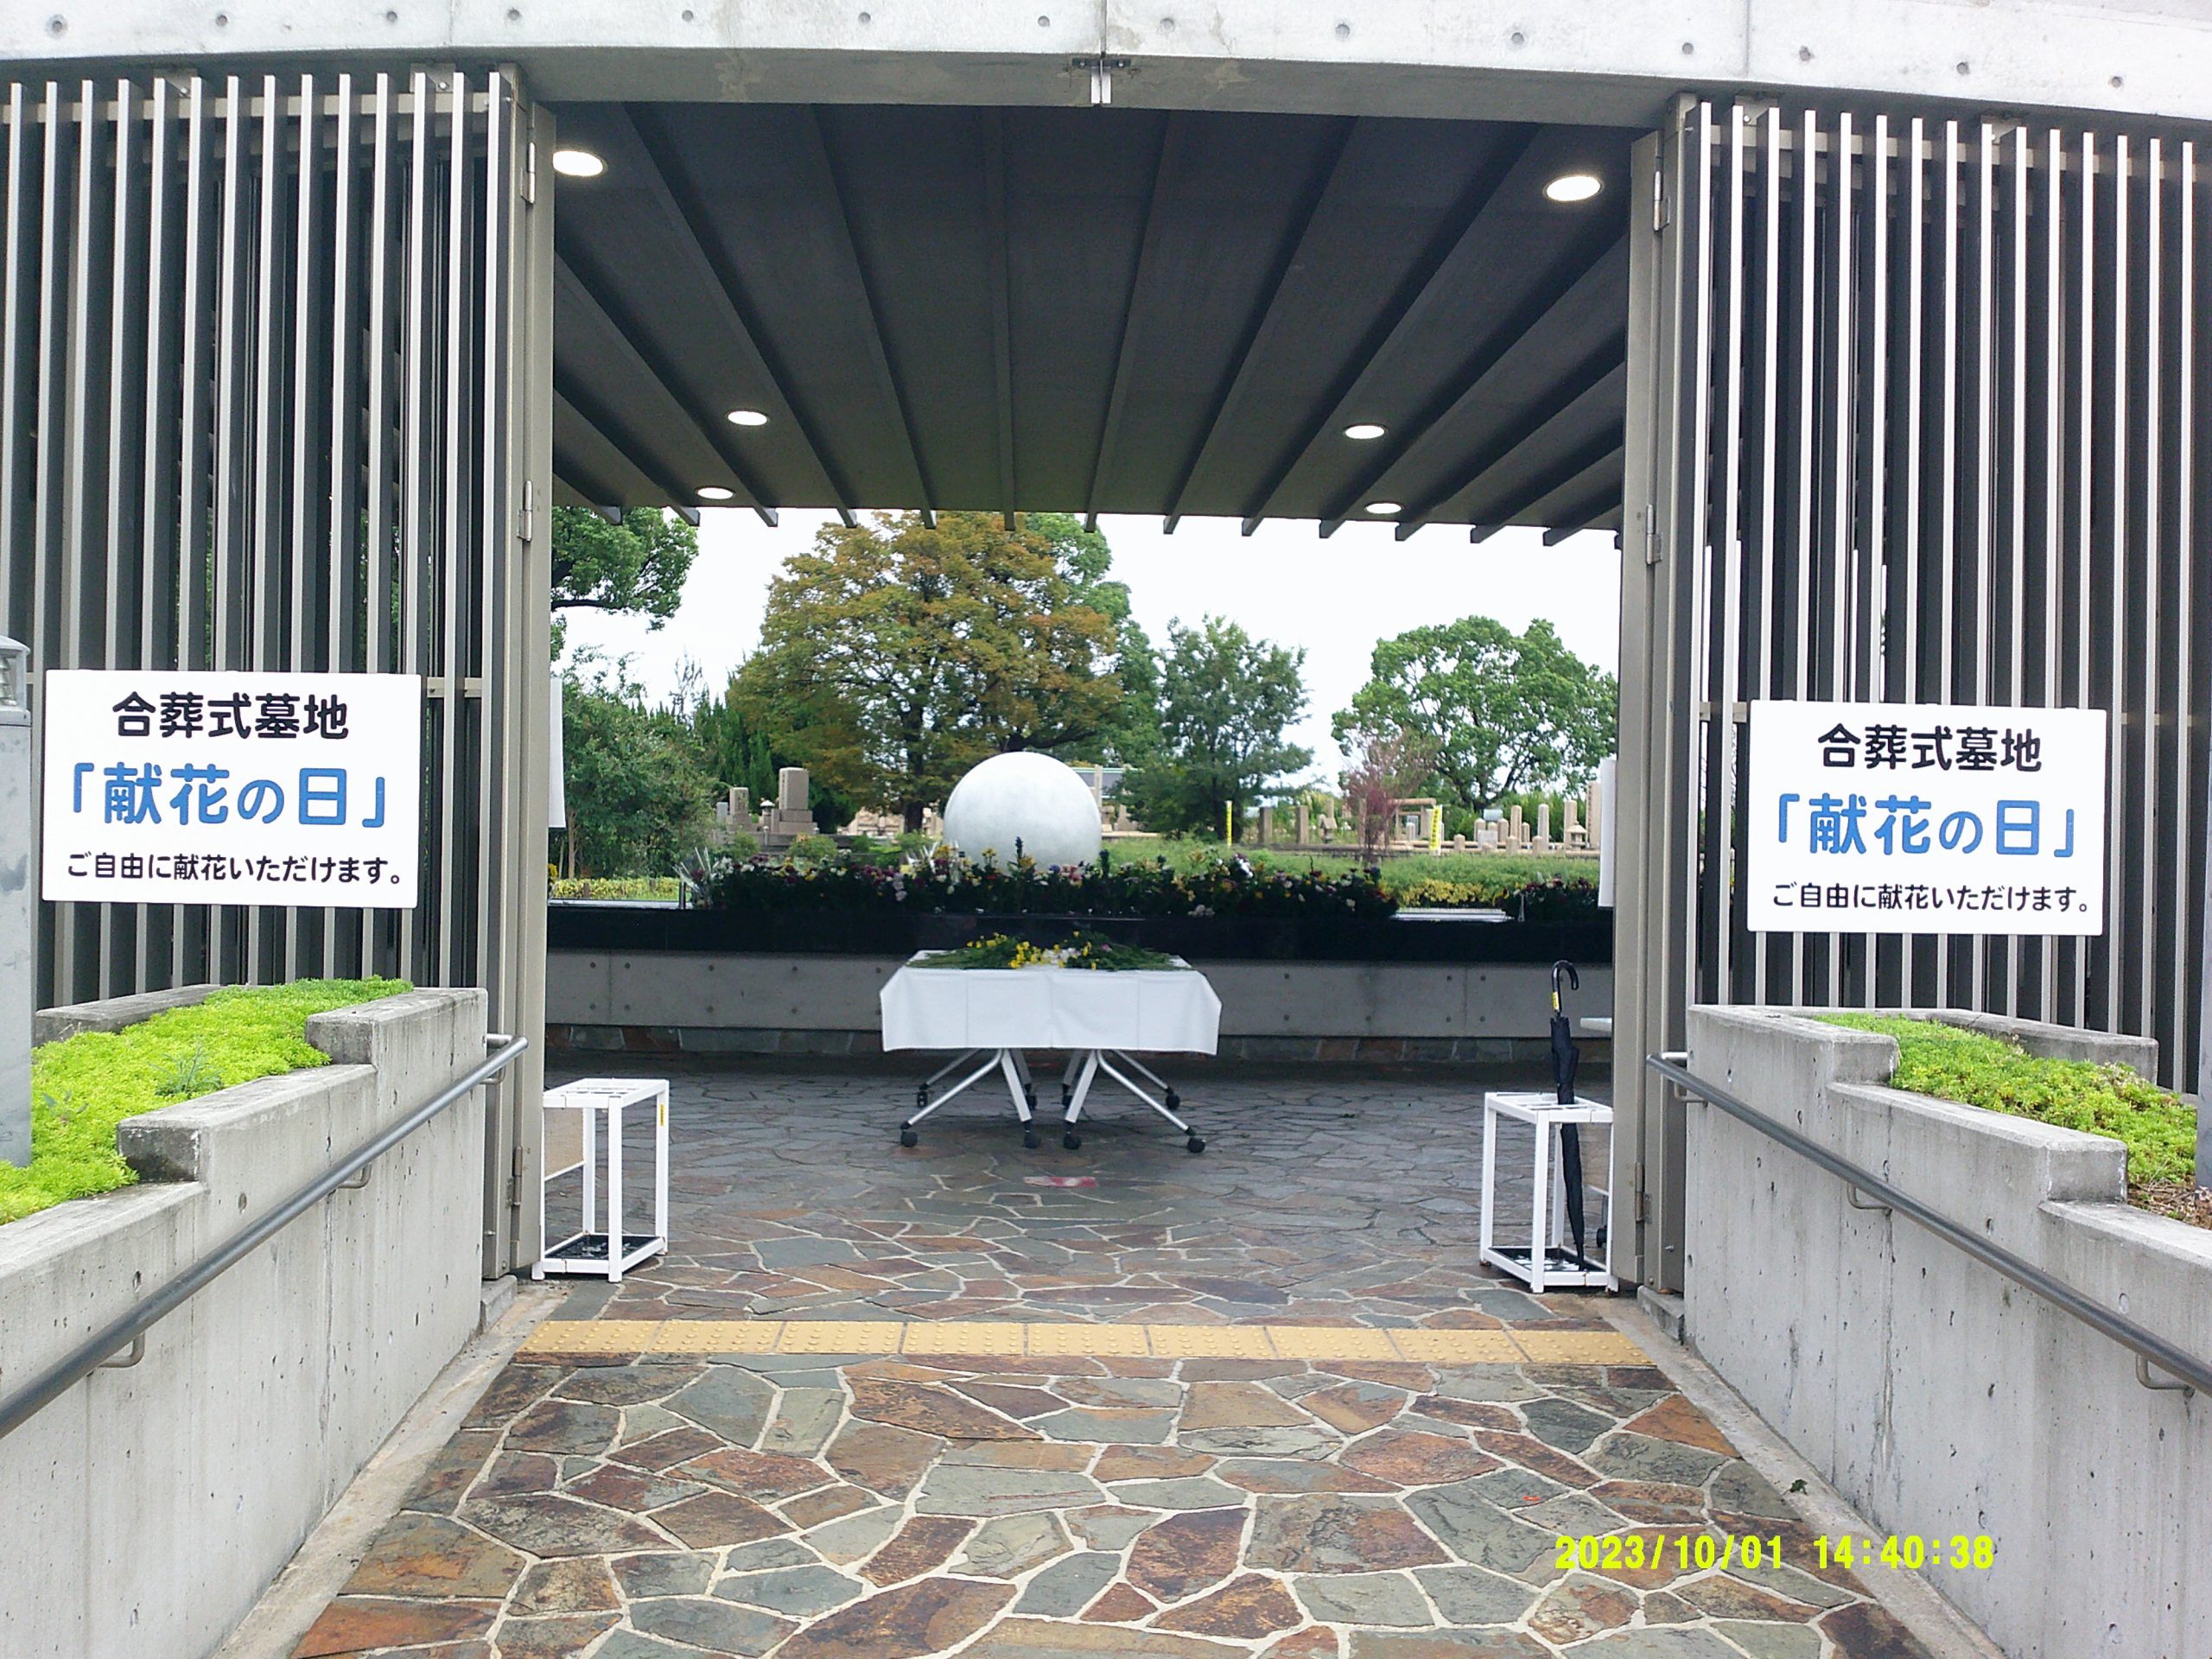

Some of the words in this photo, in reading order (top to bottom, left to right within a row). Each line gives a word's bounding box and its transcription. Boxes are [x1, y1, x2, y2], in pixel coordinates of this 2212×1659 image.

[111, 690, 349, 741] 合葬式墓地
[1817, 722, 2043, 772] 合葬式墓地
[73, 761, 385, 829] 「献花の日」
[1778, 792, 2075, 858] 「献花の日」
[67, 850, 400, 885] ご自由に献花いただけます。
[1773, 881, 2088, 912] ご自由に献花いただけます。
